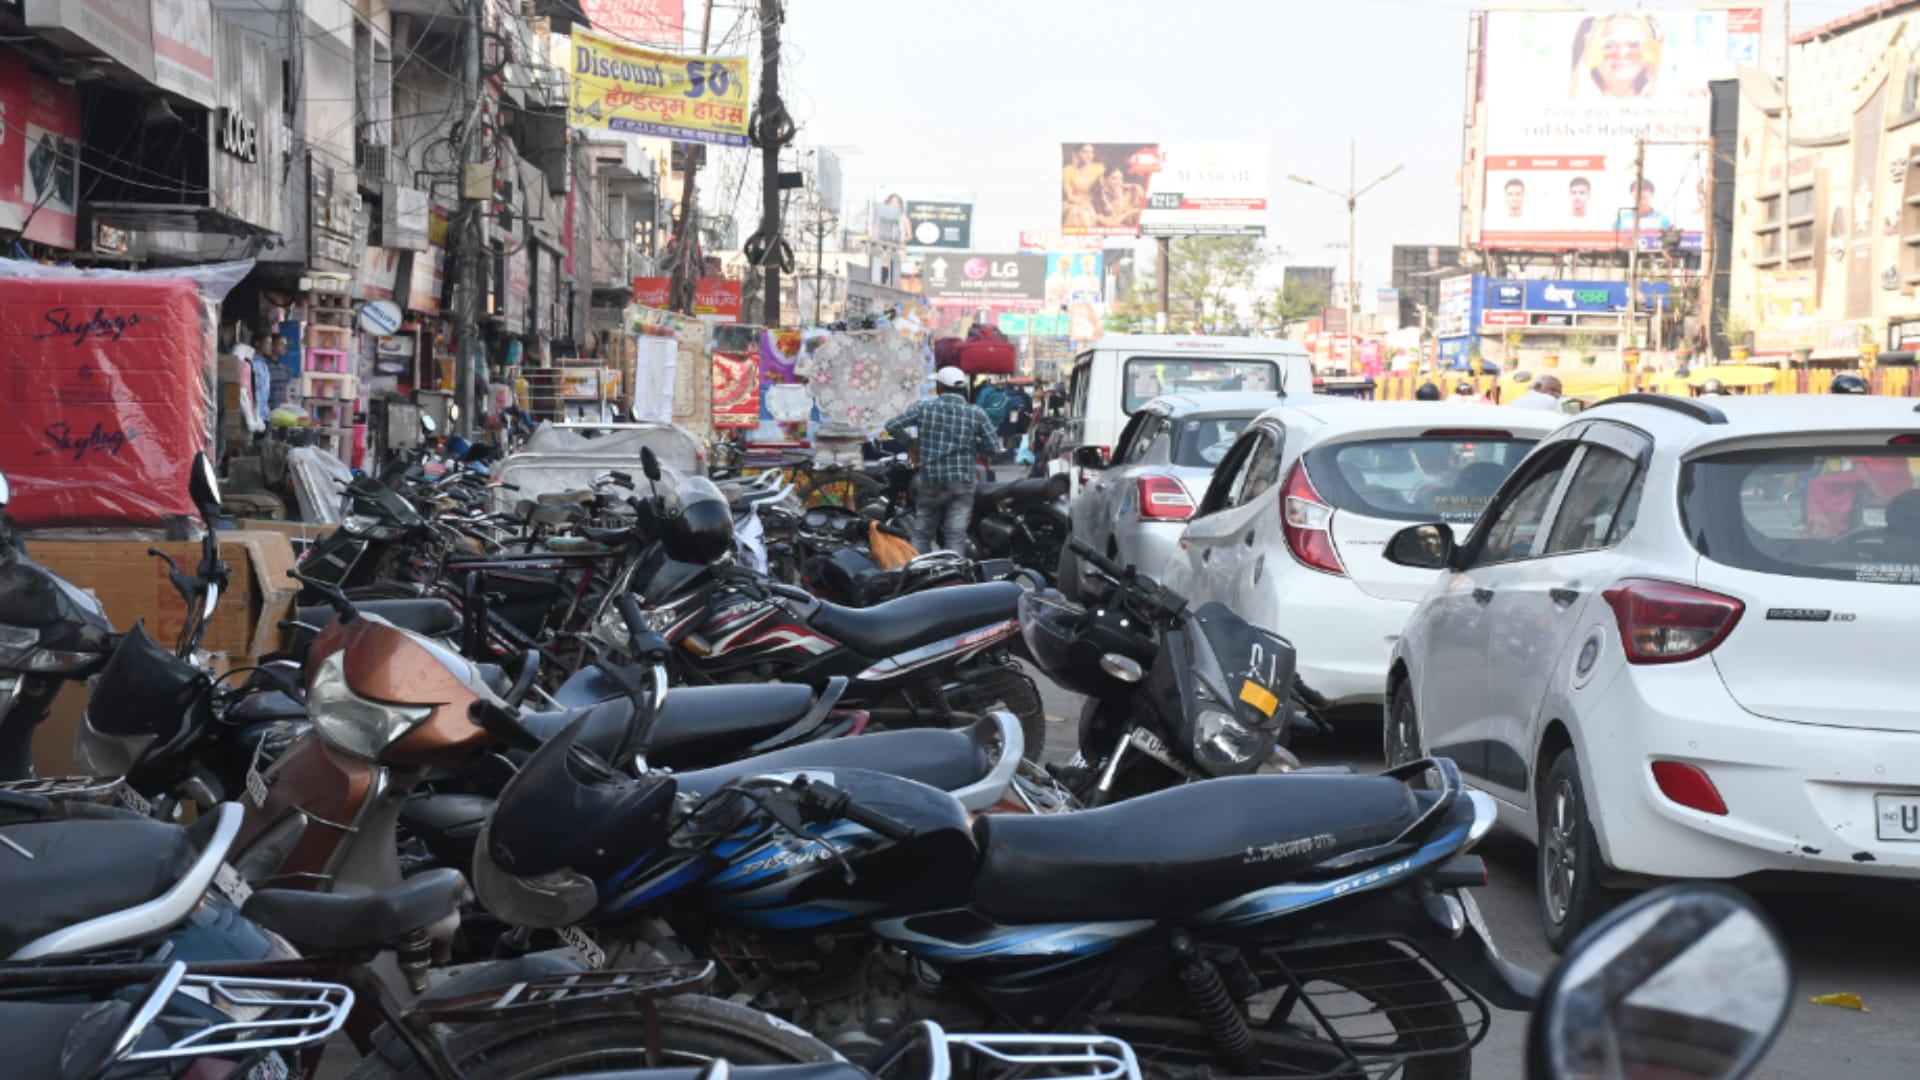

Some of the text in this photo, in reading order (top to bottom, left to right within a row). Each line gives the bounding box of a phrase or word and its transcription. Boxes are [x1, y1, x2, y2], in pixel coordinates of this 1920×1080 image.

[576, 45, 664, 88] Discount
[693, 101, 745, 123] हाउस
[990, 262, 1018, 277] LG
[34, 308, 157, 346] Skybags
[34, 422, 138, 461] Skybags
